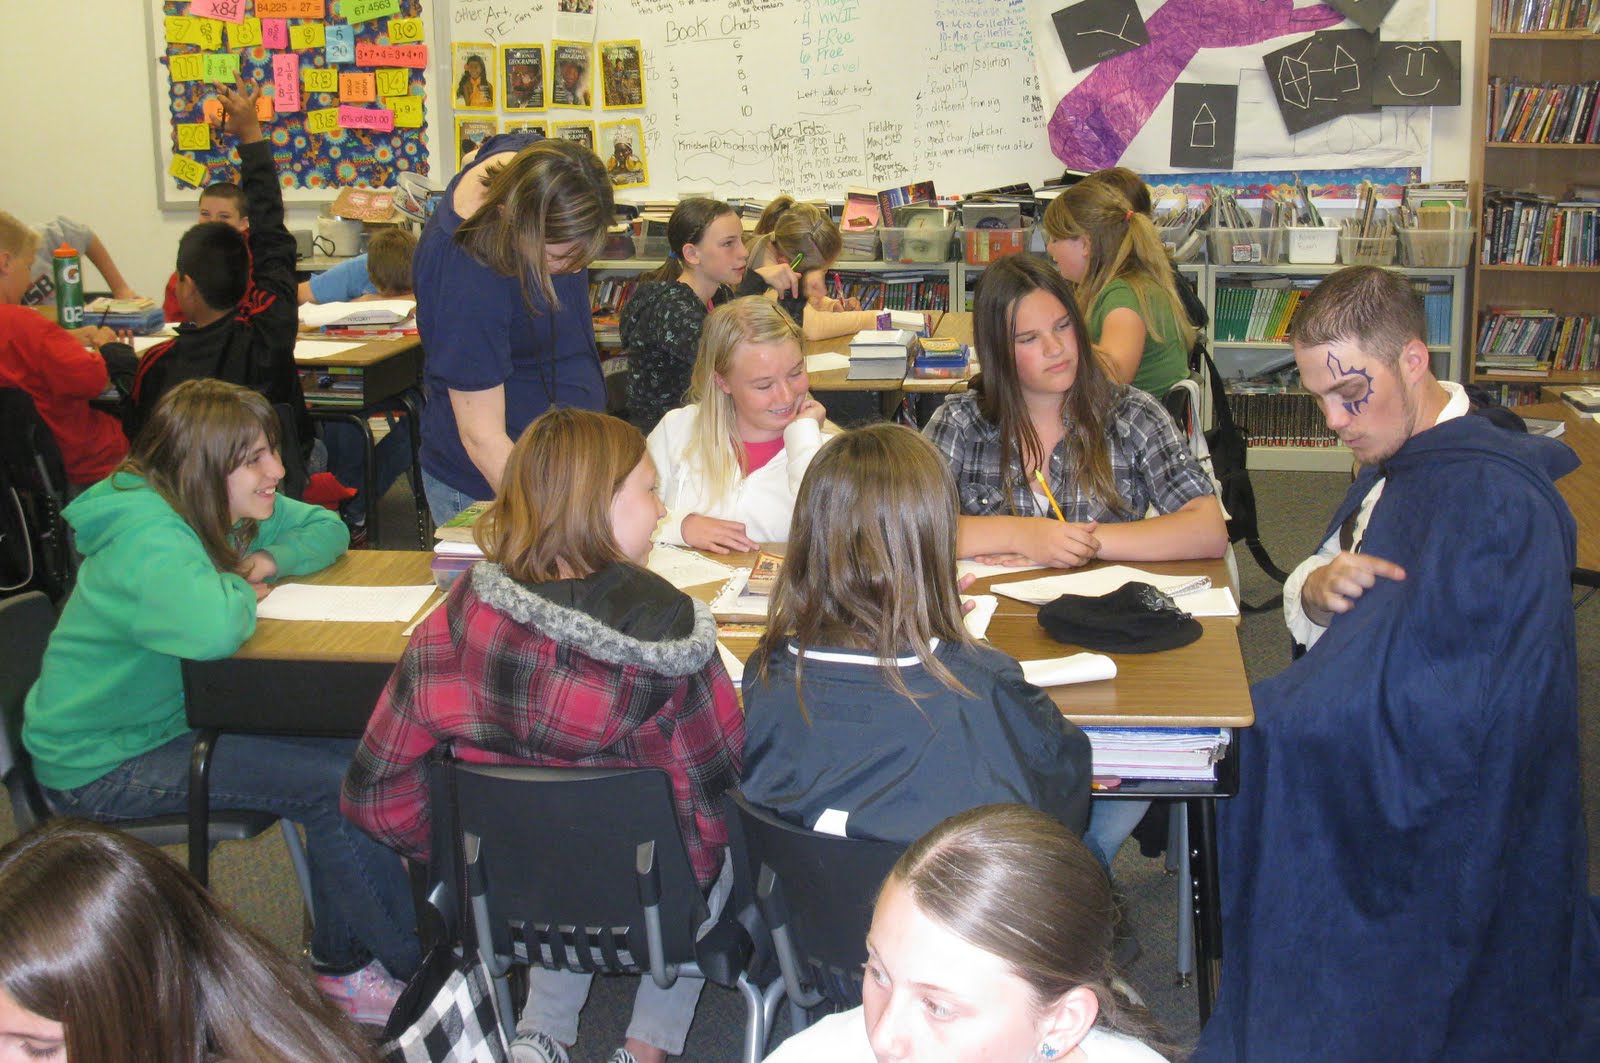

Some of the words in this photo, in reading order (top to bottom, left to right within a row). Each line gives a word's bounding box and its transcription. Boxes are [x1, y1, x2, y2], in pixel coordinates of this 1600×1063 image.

[300, 3, 311, 12] 27
[174, 20, 191, 41] 7
[236, 22, 254, 44] 8
[393, 21, 418, 41] 10
[720, 14, 760, 35] Chats
[303, 27, 315, 45] 9
[336, 30, 344, 41] 5
[733, 40, 741, 49] 6
[801, 32, 812, 46] 5
[736, 55, 743, 65] 7
[311, 71, 332, 89] 13
[378, 71, 405, 95] 14
[738, 69, 746, 80] 8
[741, 105, 753, 117] 10
[179, 124, 208, 148] 20
[175, 159, 199, 182] 12
[63, 264, 80, 284] G
